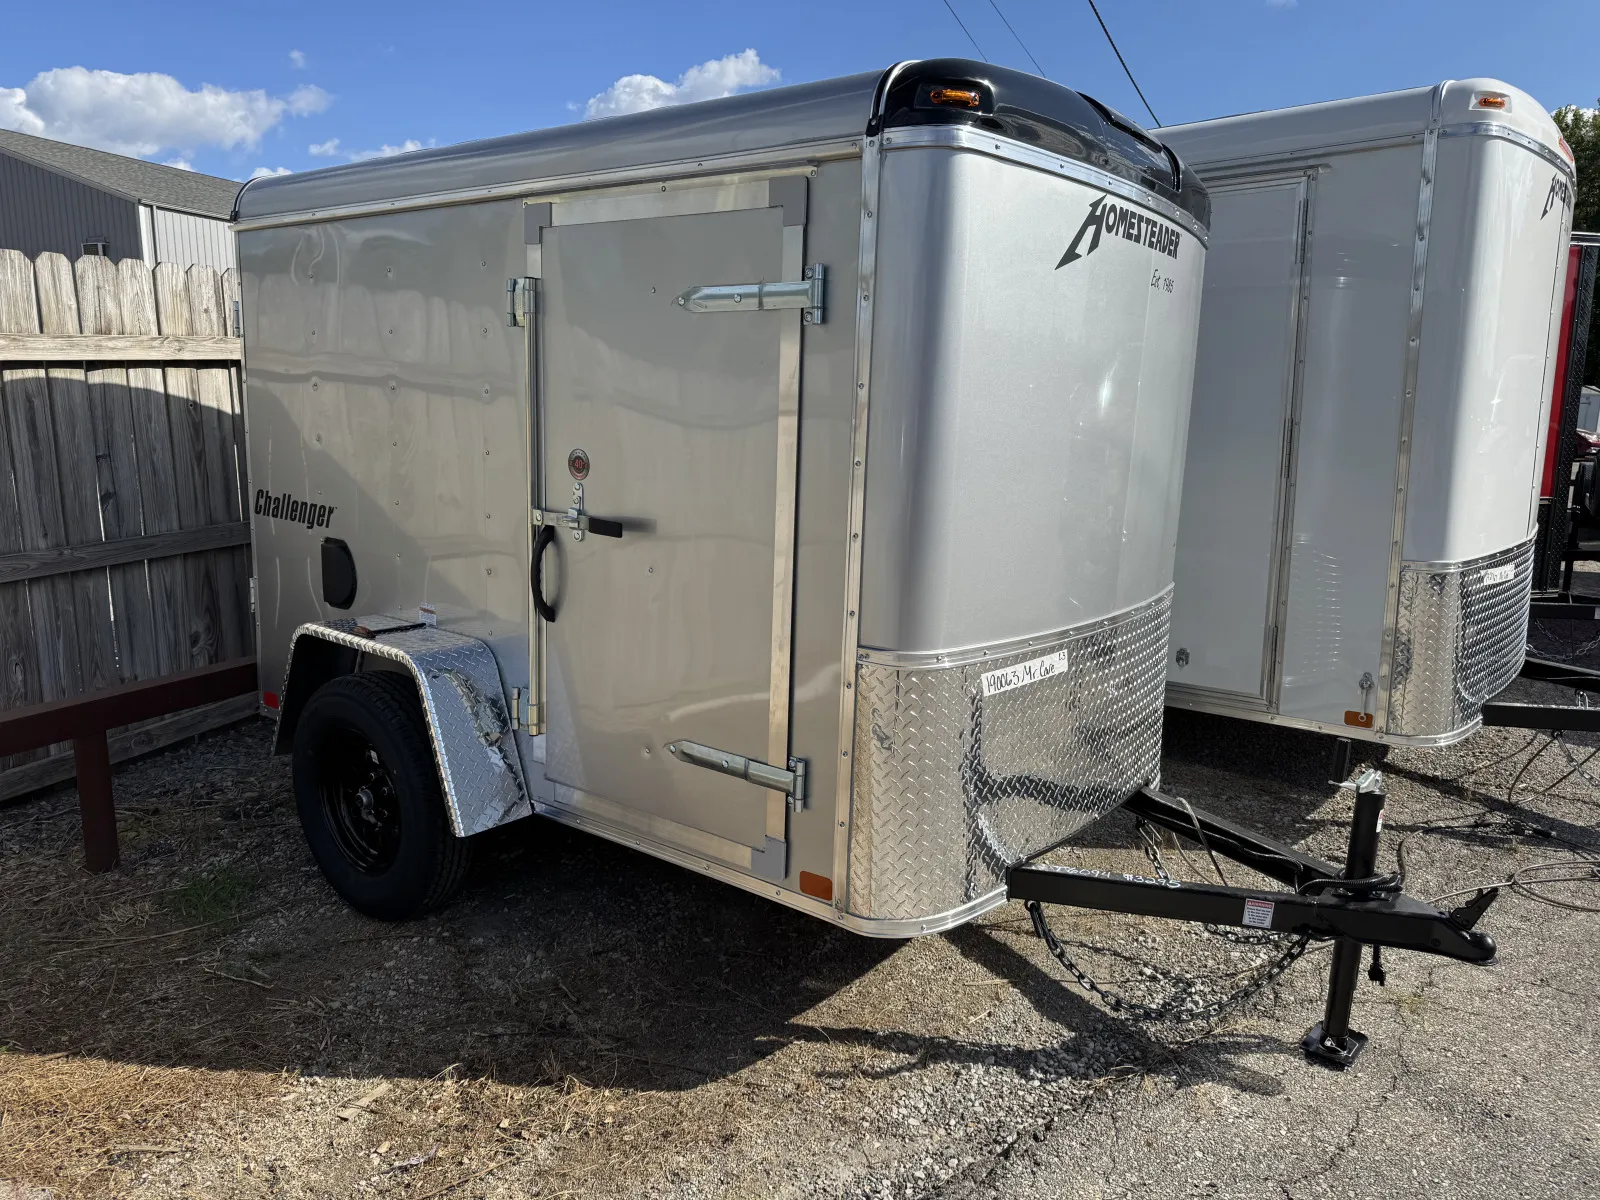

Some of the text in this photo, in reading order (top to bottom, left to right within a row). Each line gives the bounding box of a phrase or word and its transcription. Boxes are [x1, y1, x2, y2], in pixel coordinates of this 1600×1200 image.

[1054, 193, 1181, 270] HOMESTEADER
[254, 488, 335, 530] Challenger
[986, 670, 1020, 694] 190063
